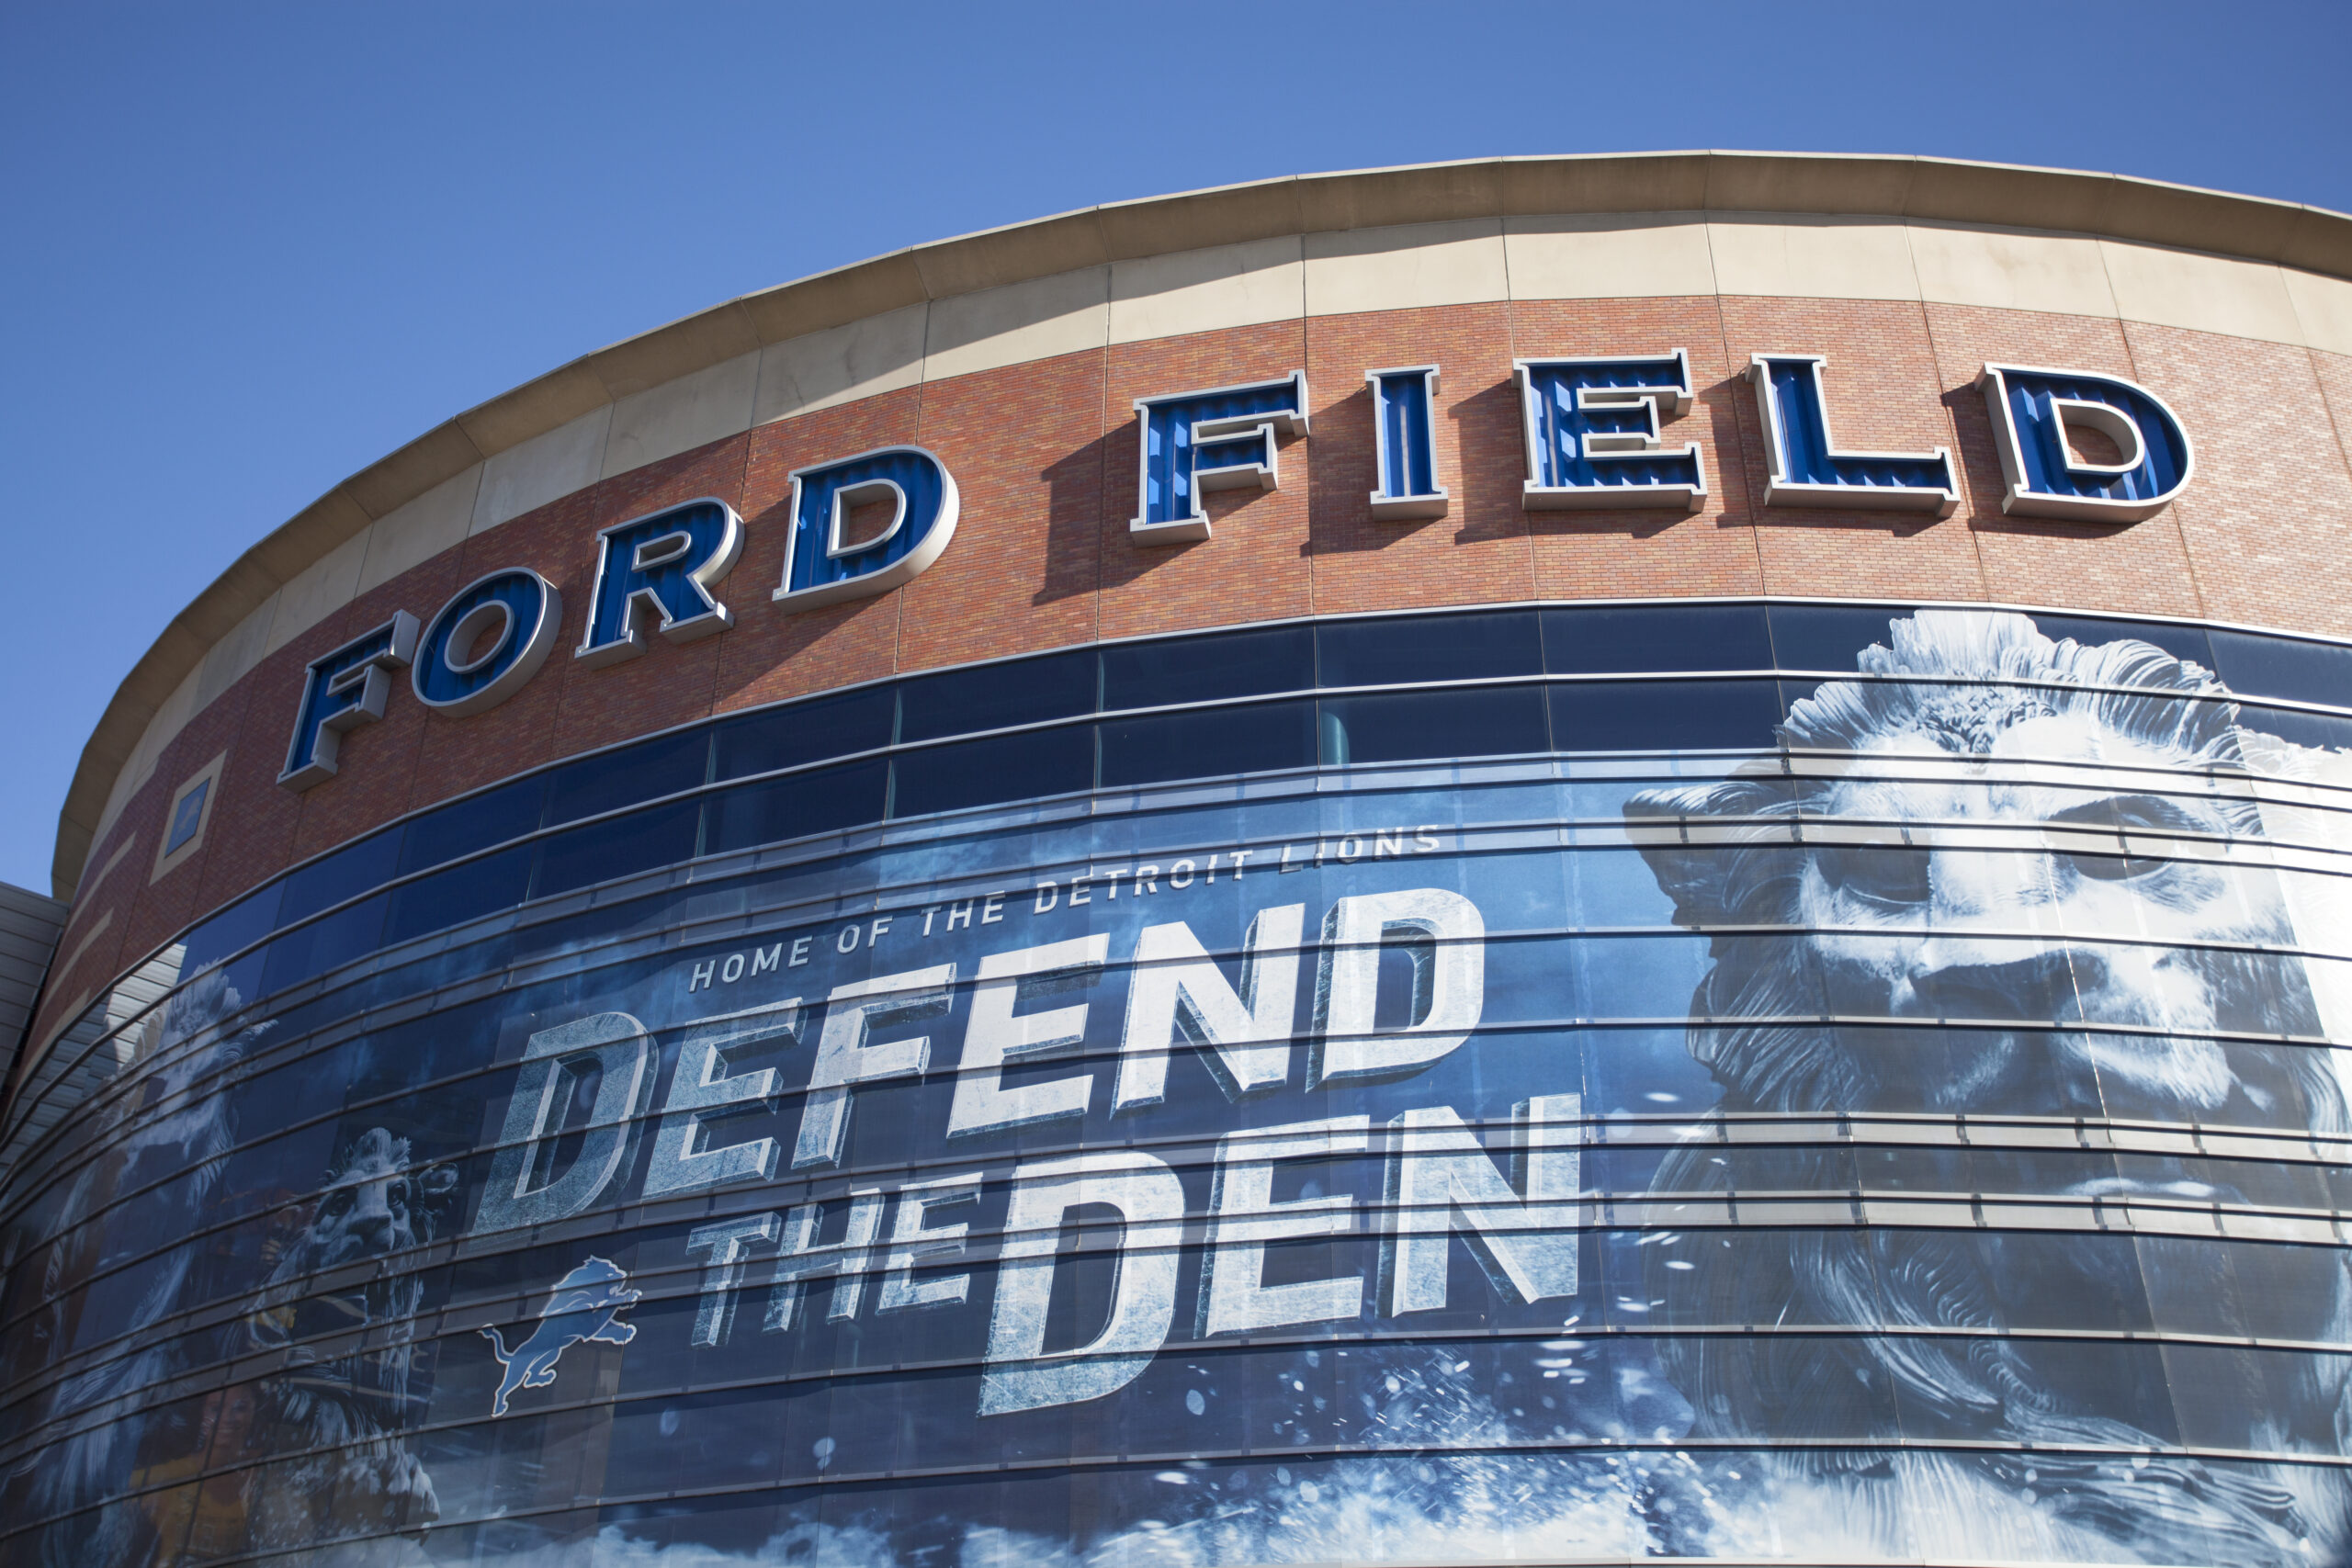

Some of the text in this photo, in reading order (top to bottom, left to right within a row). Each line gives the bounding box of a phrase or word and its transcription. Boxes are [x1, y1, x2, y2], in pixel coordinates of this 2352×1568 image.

[277, 348, 2195, 794] FORD FIELD
[471, 888, 1486, 1242] DEFEND
[688, 824, 1442, 993] HOME OF THE DETROIT LIONS
[684, 1092, 1582, 1416] THE DEN
